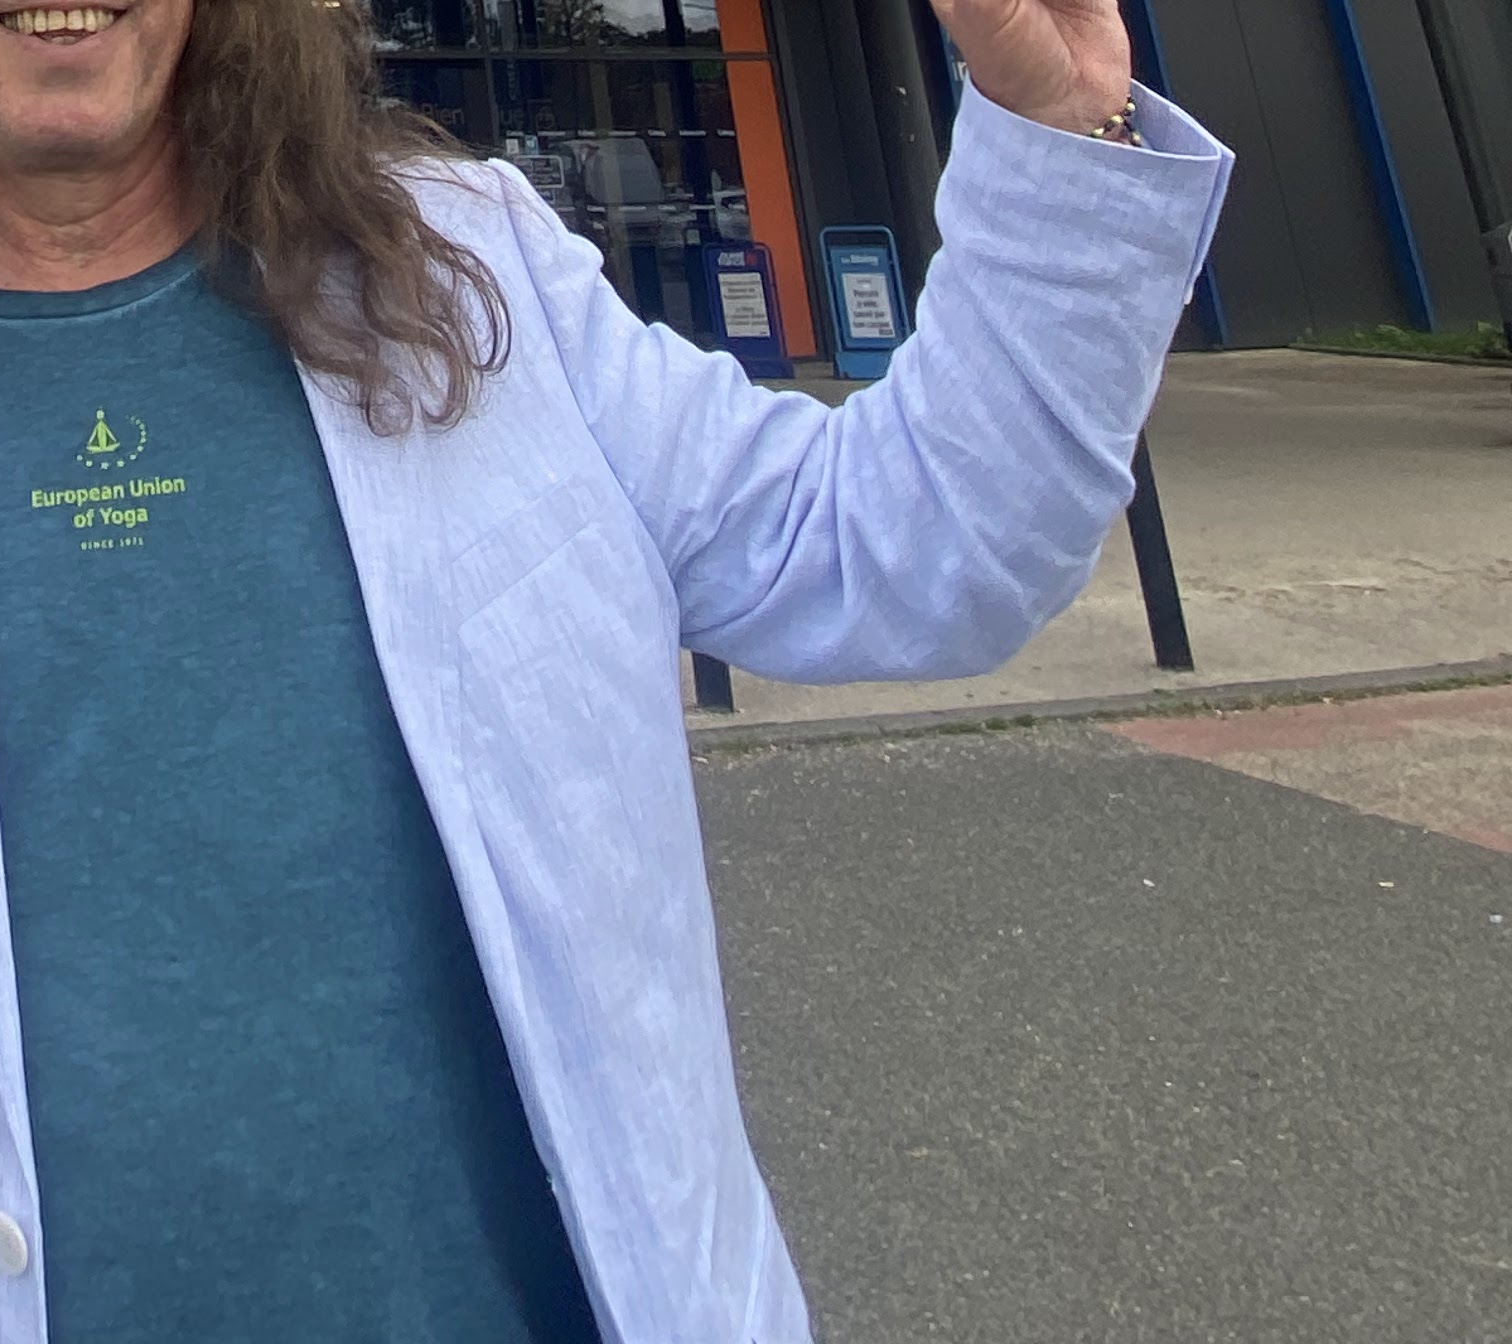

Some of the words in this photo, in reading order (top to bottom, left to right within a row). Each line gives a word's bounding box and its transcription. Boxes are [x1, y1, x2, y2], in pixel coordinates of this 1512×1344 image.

[31, 484, 125, 508] European
[129, 476, 186, 498] Union
[73, 508, 95, 529] of
[99, 506, 149, 529] Yoga
[80, 538, 114, 551] SINCE
